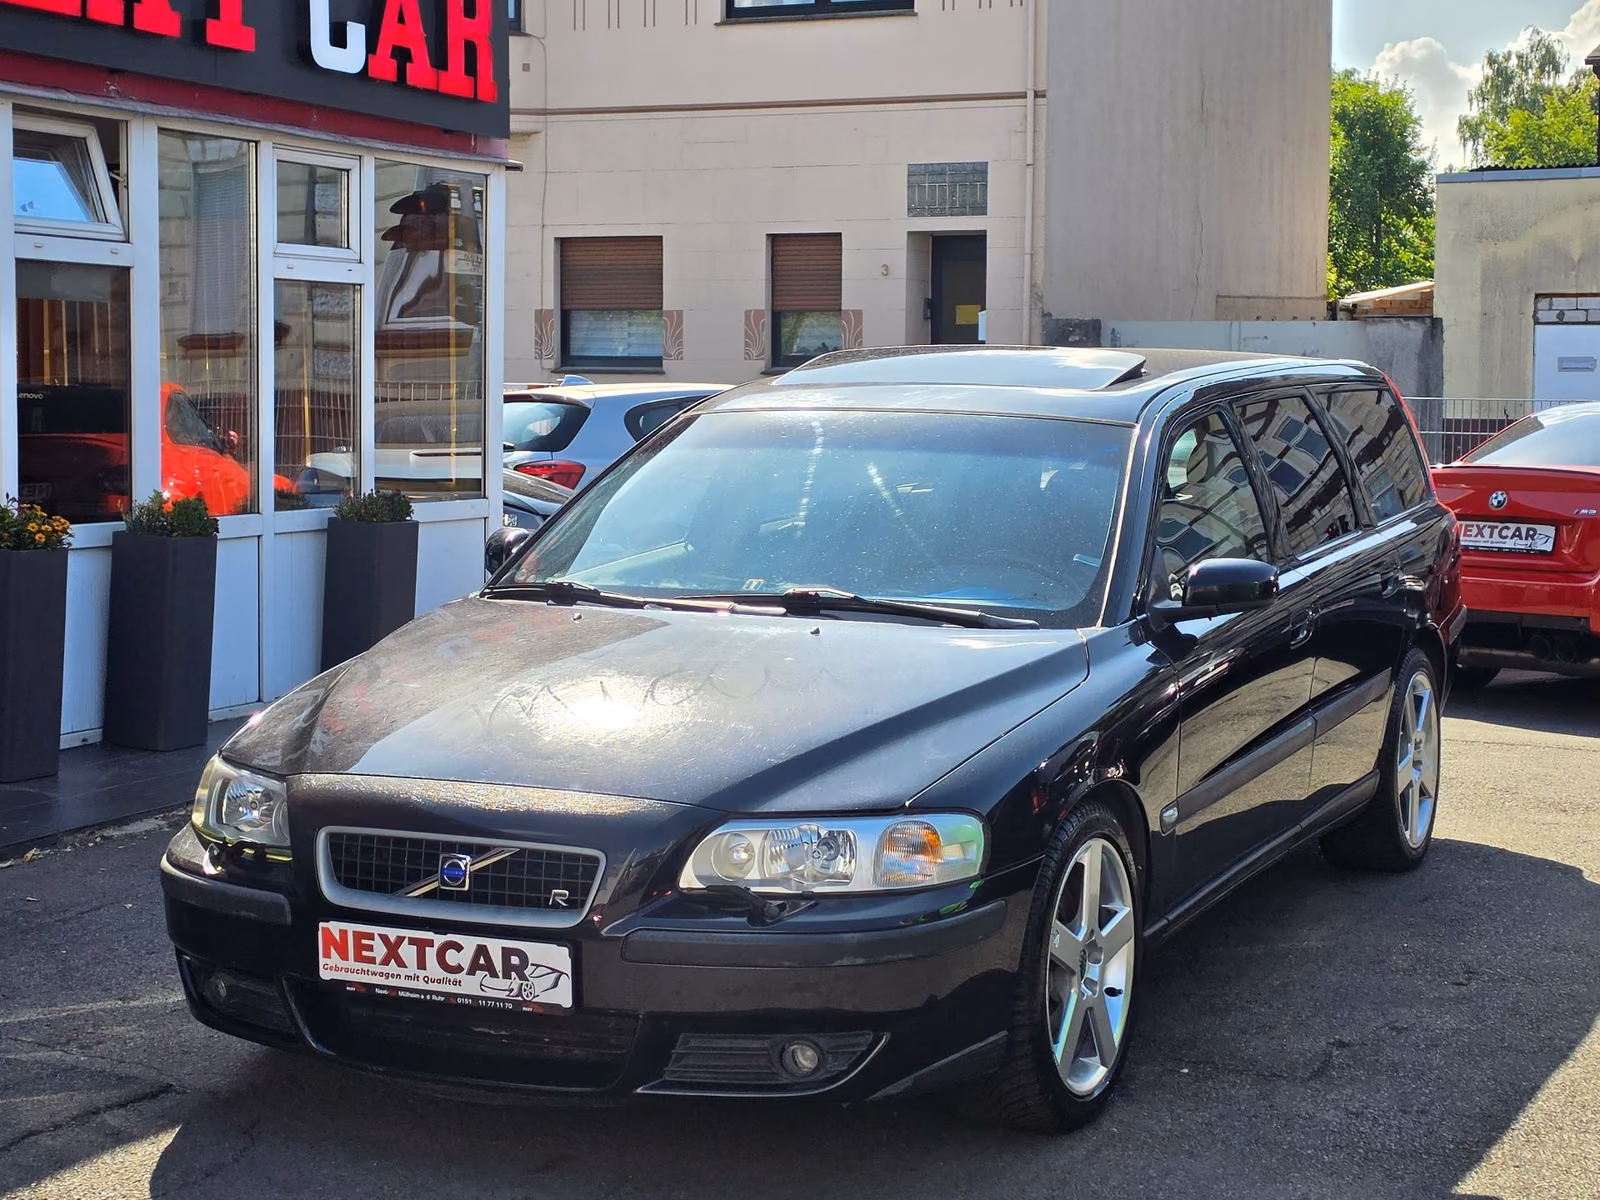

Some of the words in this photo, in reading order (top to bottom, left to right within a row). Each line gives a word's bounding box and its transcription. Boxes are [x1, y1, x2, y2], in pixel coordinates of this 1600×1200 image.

[881, 263, 889, 276] 3
[18, 392, 44, 400] enovo
[548, 889, 570, 907] R
[321, 926, 530, 982] NEXTCAR
[322, 963, 402, 980] Gebrauchtwagen
[404, 972, 420, 982] mit
[422, 975, 462, 987] Qualität
[456, 997, 472, 1005] 0151
